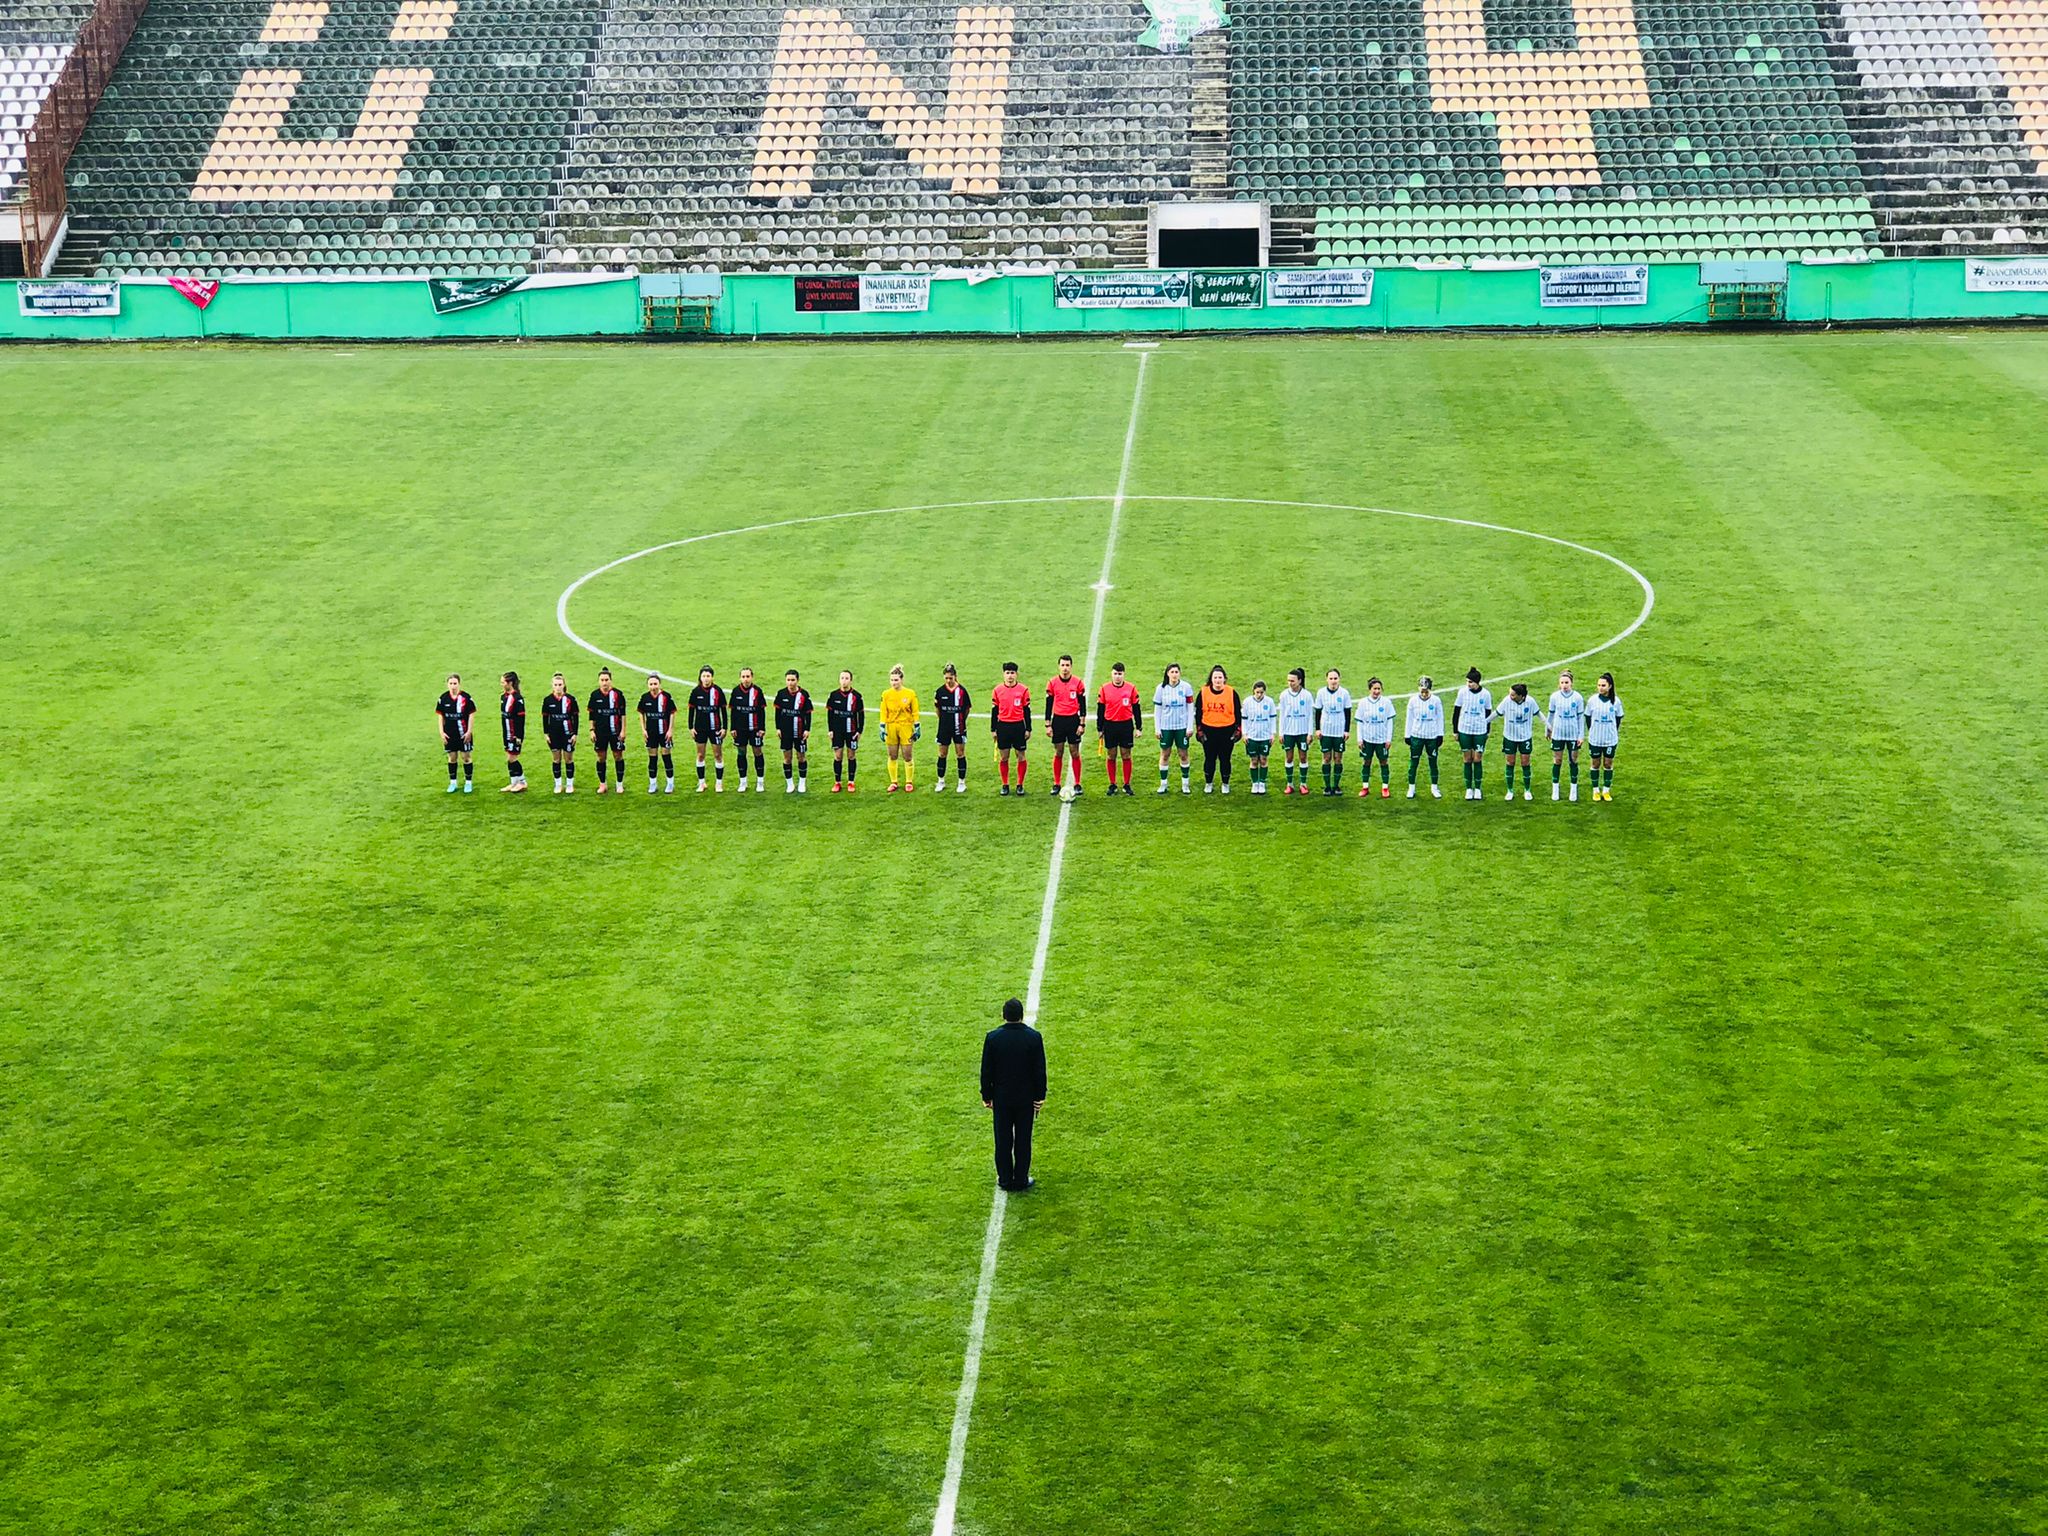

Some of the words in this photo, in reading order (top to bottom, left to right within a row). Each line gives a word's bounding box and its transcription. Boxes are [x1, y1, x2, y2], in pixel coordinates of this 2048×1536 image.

[1328, 272, 1354, 281] YOLUNDA
[865, 277, 906, 290] İNANANLAR
[908, 278, 927, 289] ASLA
[1091, 284, 1155, 296] ÜNYESPOR'UM
[875, 292, 916, 303] KAYBETMEZ
